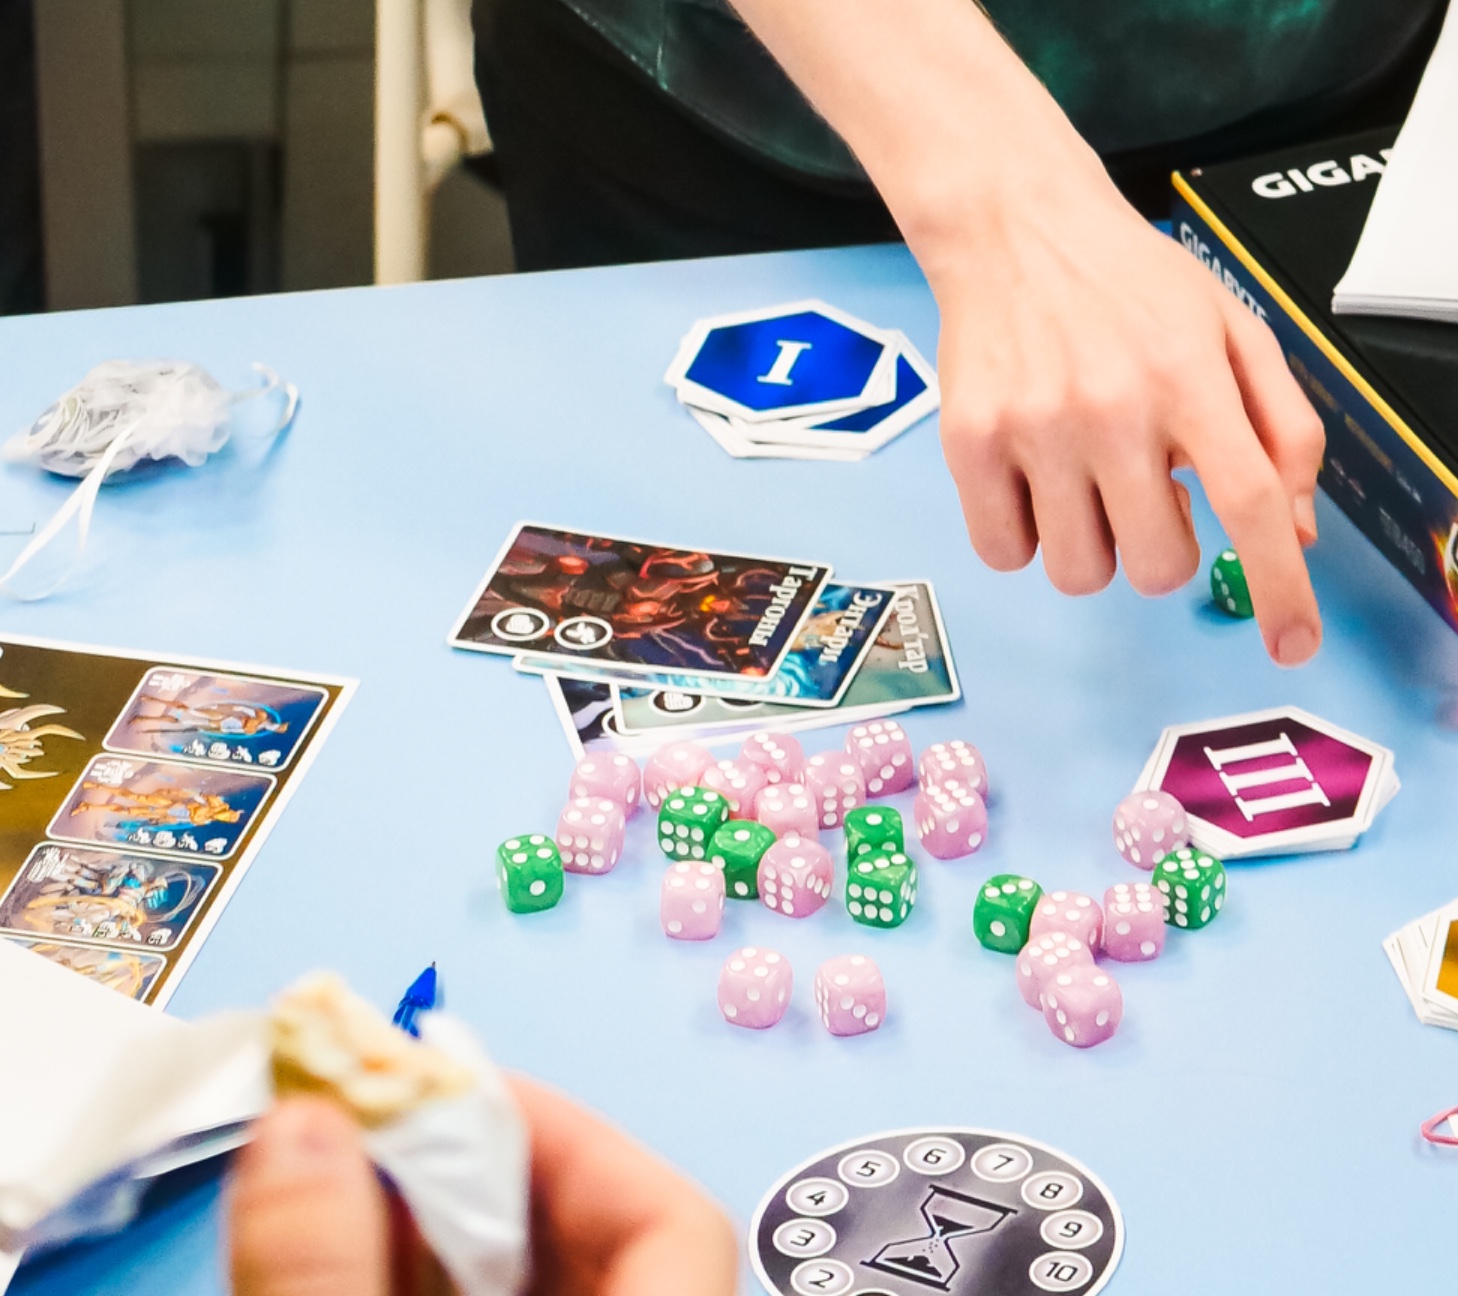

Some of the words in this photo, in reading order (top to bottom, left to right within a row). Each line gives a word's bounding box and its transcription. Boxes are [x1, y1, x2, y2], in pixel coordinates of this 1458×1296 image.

[1251, 147, 1396, 199] GIGA
[757, 340, 813, 386] I
[748, 565, 818, 647] Таргоны
[818, 590, 884, 664] Энтари
[1204, 732, 1332, 822] III
[922, 1148, 947, 1166] 6
[991, 1153, 1015, 1172] 7
[855, 1160, 882, 1179] 5
[806, 1190, 827, 1207] 4
[1039, 1182, 1064, 1200] 8
[790, 1229, 816, 1247] 3
[1059, 1221, 1083, 1239] 9
[809, 1269, 835, 1289] 2
[1045, 1261, 1079, 1283] 10
